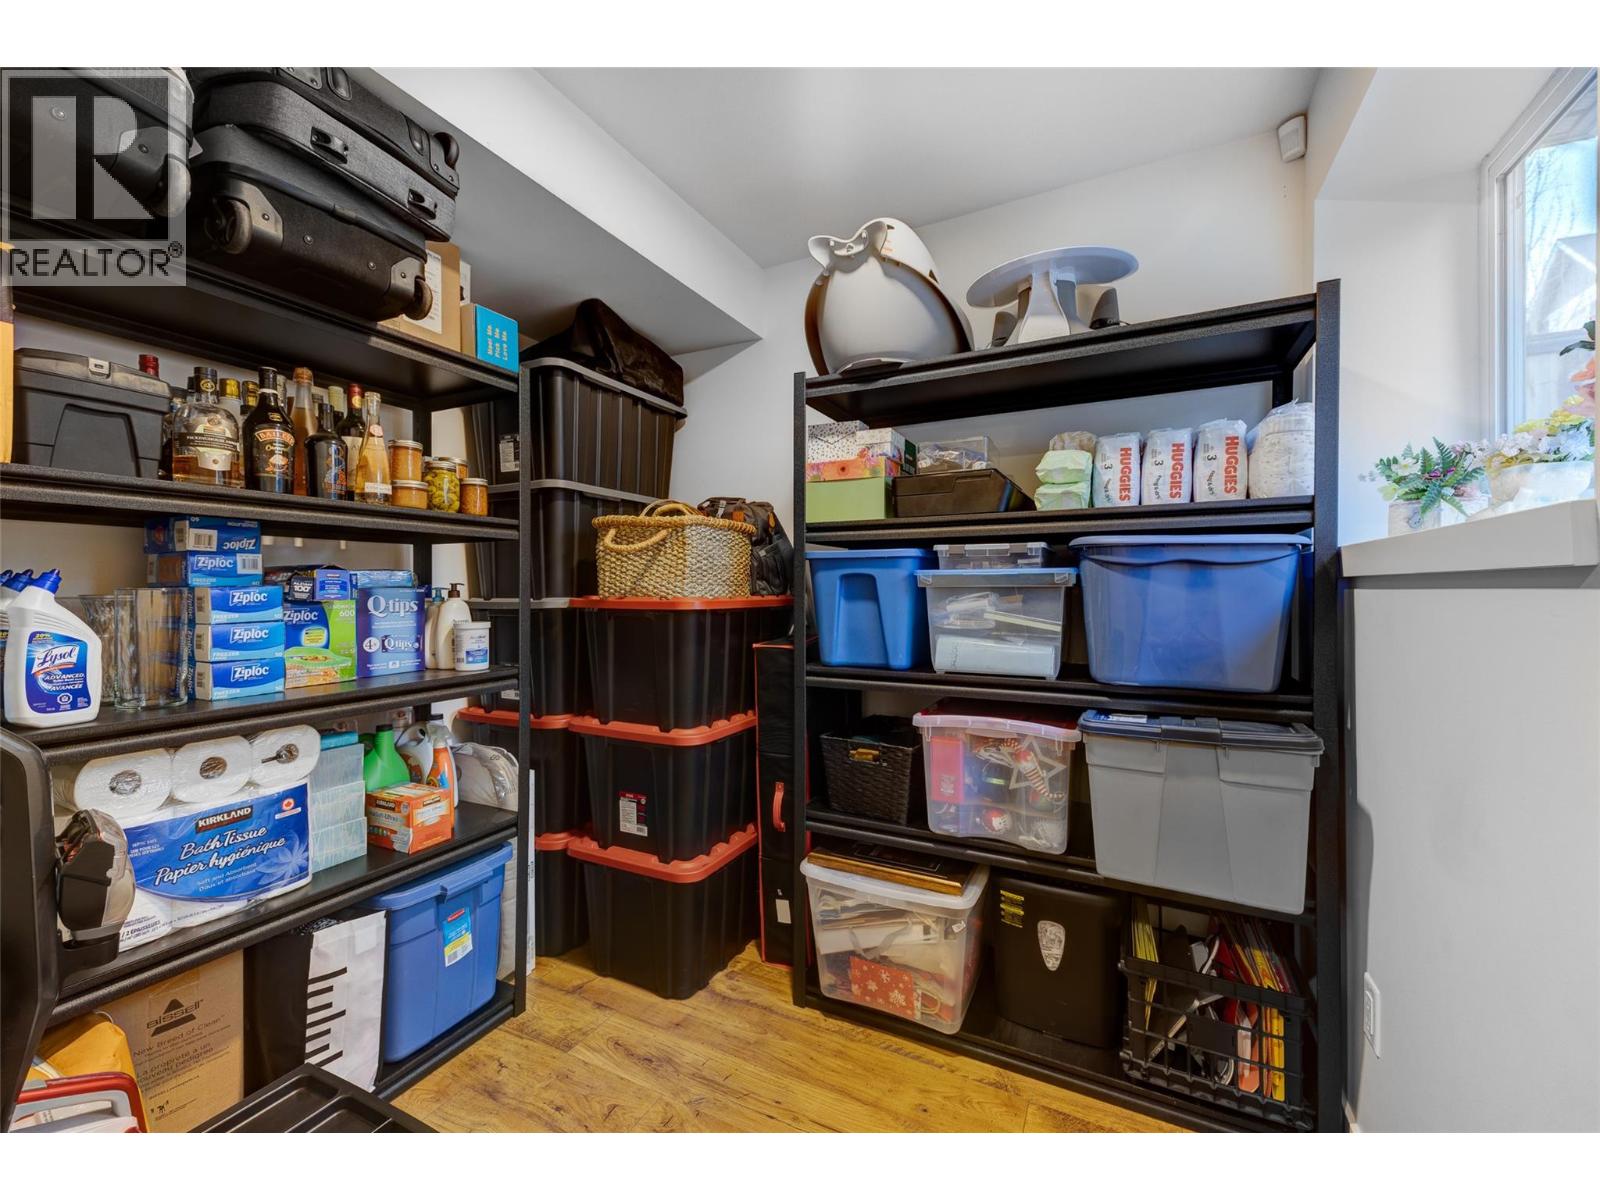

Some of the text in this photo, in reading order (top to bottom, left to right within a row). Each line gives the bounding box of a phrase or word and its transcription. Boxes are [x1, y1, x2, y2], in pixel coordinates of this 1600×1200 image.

[1169, 443, 1184, 498] HUGGIES
[1224, 435, 1239, 494] HUGGIES
[1119, 447, 1132, 501] HUGGIES
[223, 539, 256, 551] Ziploc
[197, 556, 234, 570] Ziploc
[232, 591, 268, 605] Ziploc
[283, 610, 318, 624] Ziploc
[233, 628, 269, 642] Ziploc
[37, 648, 76, 667] Lysol
[44, 673, 84, 681] ADVANCED
[234, 665, 269, 680] Ziploc
[198, 807, 252, 828] KIRKLAND
[179, 835, 223, 860] Bath
[221, 827, 268, 848] Tissue
[154, 837, 286, 886] Papier hygiénique
[133, 1045, 154, 1058] New
